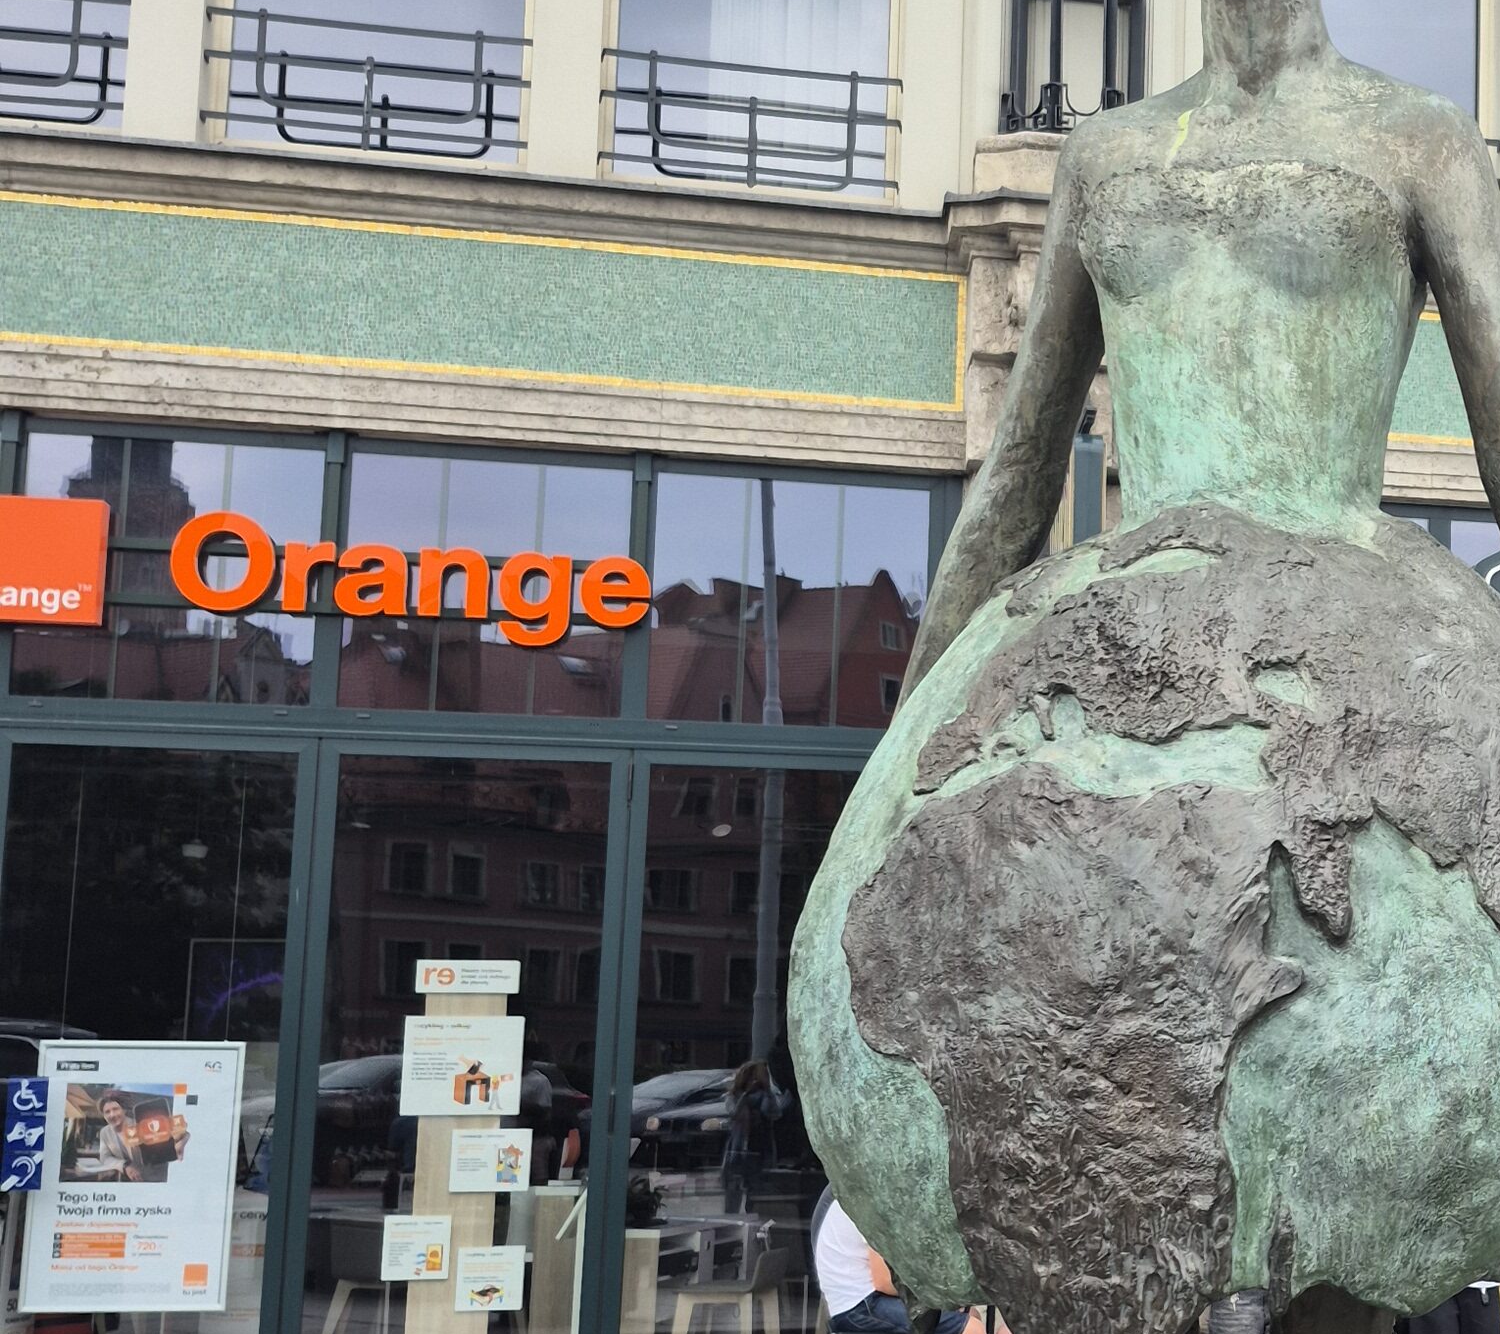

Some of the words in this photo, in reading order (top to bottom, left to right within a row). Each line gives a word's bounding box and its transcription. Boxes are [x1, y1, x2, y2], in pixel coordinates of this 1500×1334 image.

[170, 511, 651, 647] Orange
[57, 1191, 88, 1205] Tego
[92, 1191, 117, 1203] lata
[57, 1204, 93, 1218] Twoja
[98, 1205, 132, 1216] firma
[135, 1205, 172, 1218] zyska
